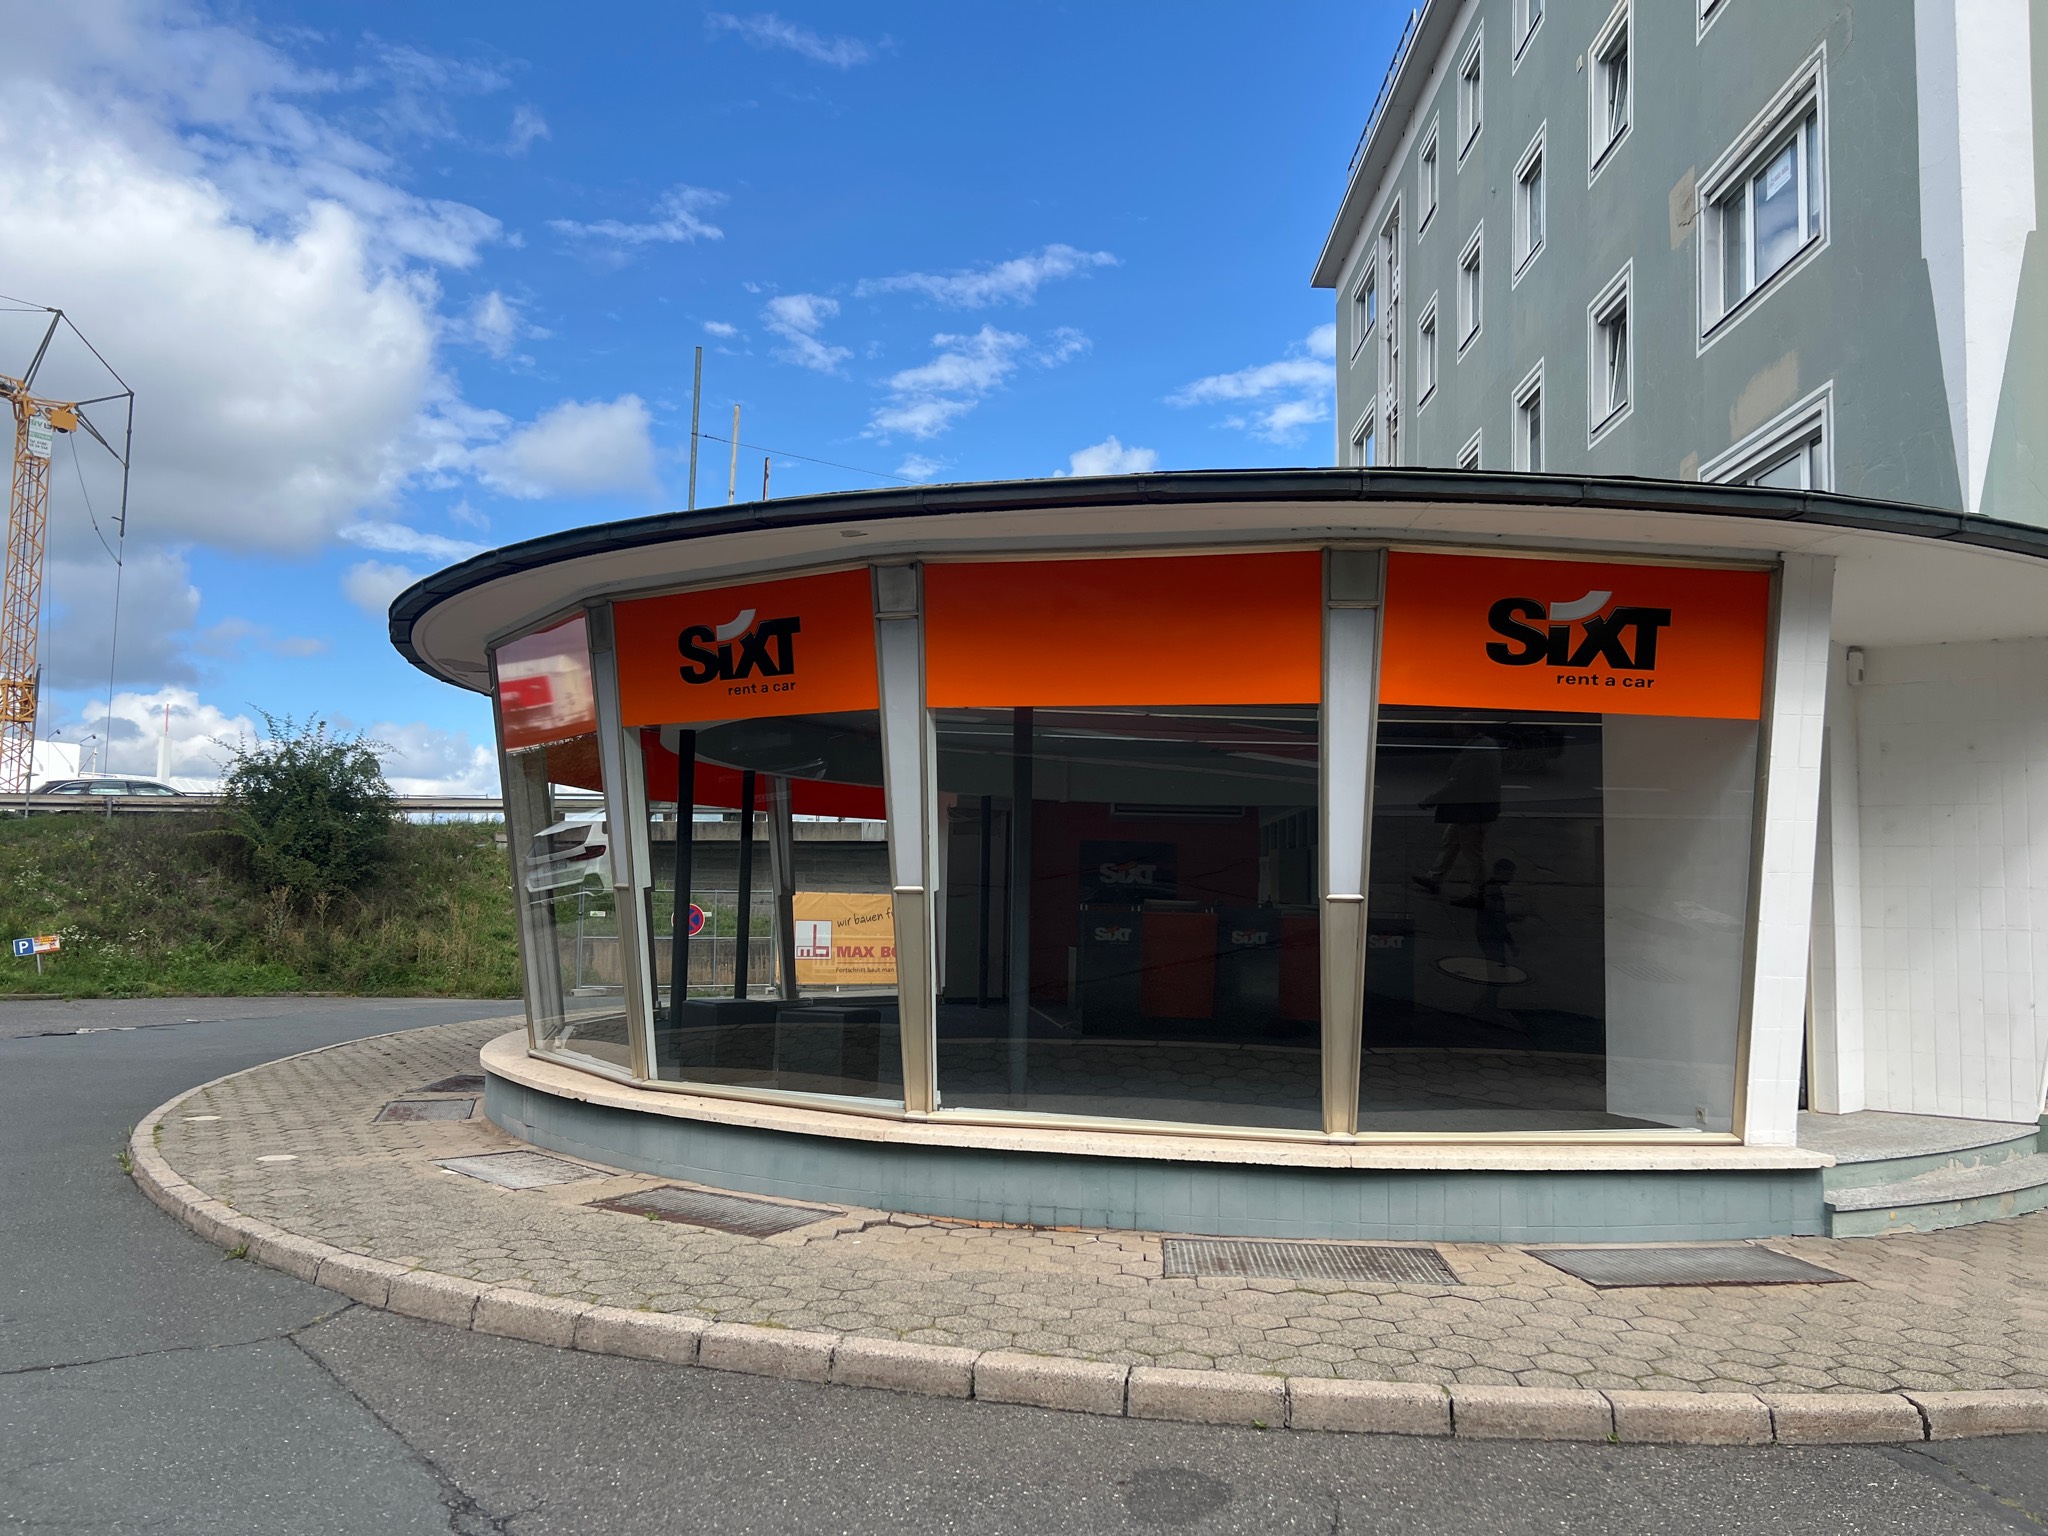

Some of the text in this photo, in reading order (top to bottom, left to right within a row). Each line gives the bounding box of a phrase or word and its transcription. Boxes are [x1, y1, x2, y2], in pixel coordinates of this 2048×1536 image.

[728, 681, 796, 696] rent a car
[1556, 674, 1655, 689] rent a car
[837, 917, 851, 928] wir
[853, 913, 883, 924] bauen
[18, 941, 28, 953] P
[836, 946, 875, 957] MAX
